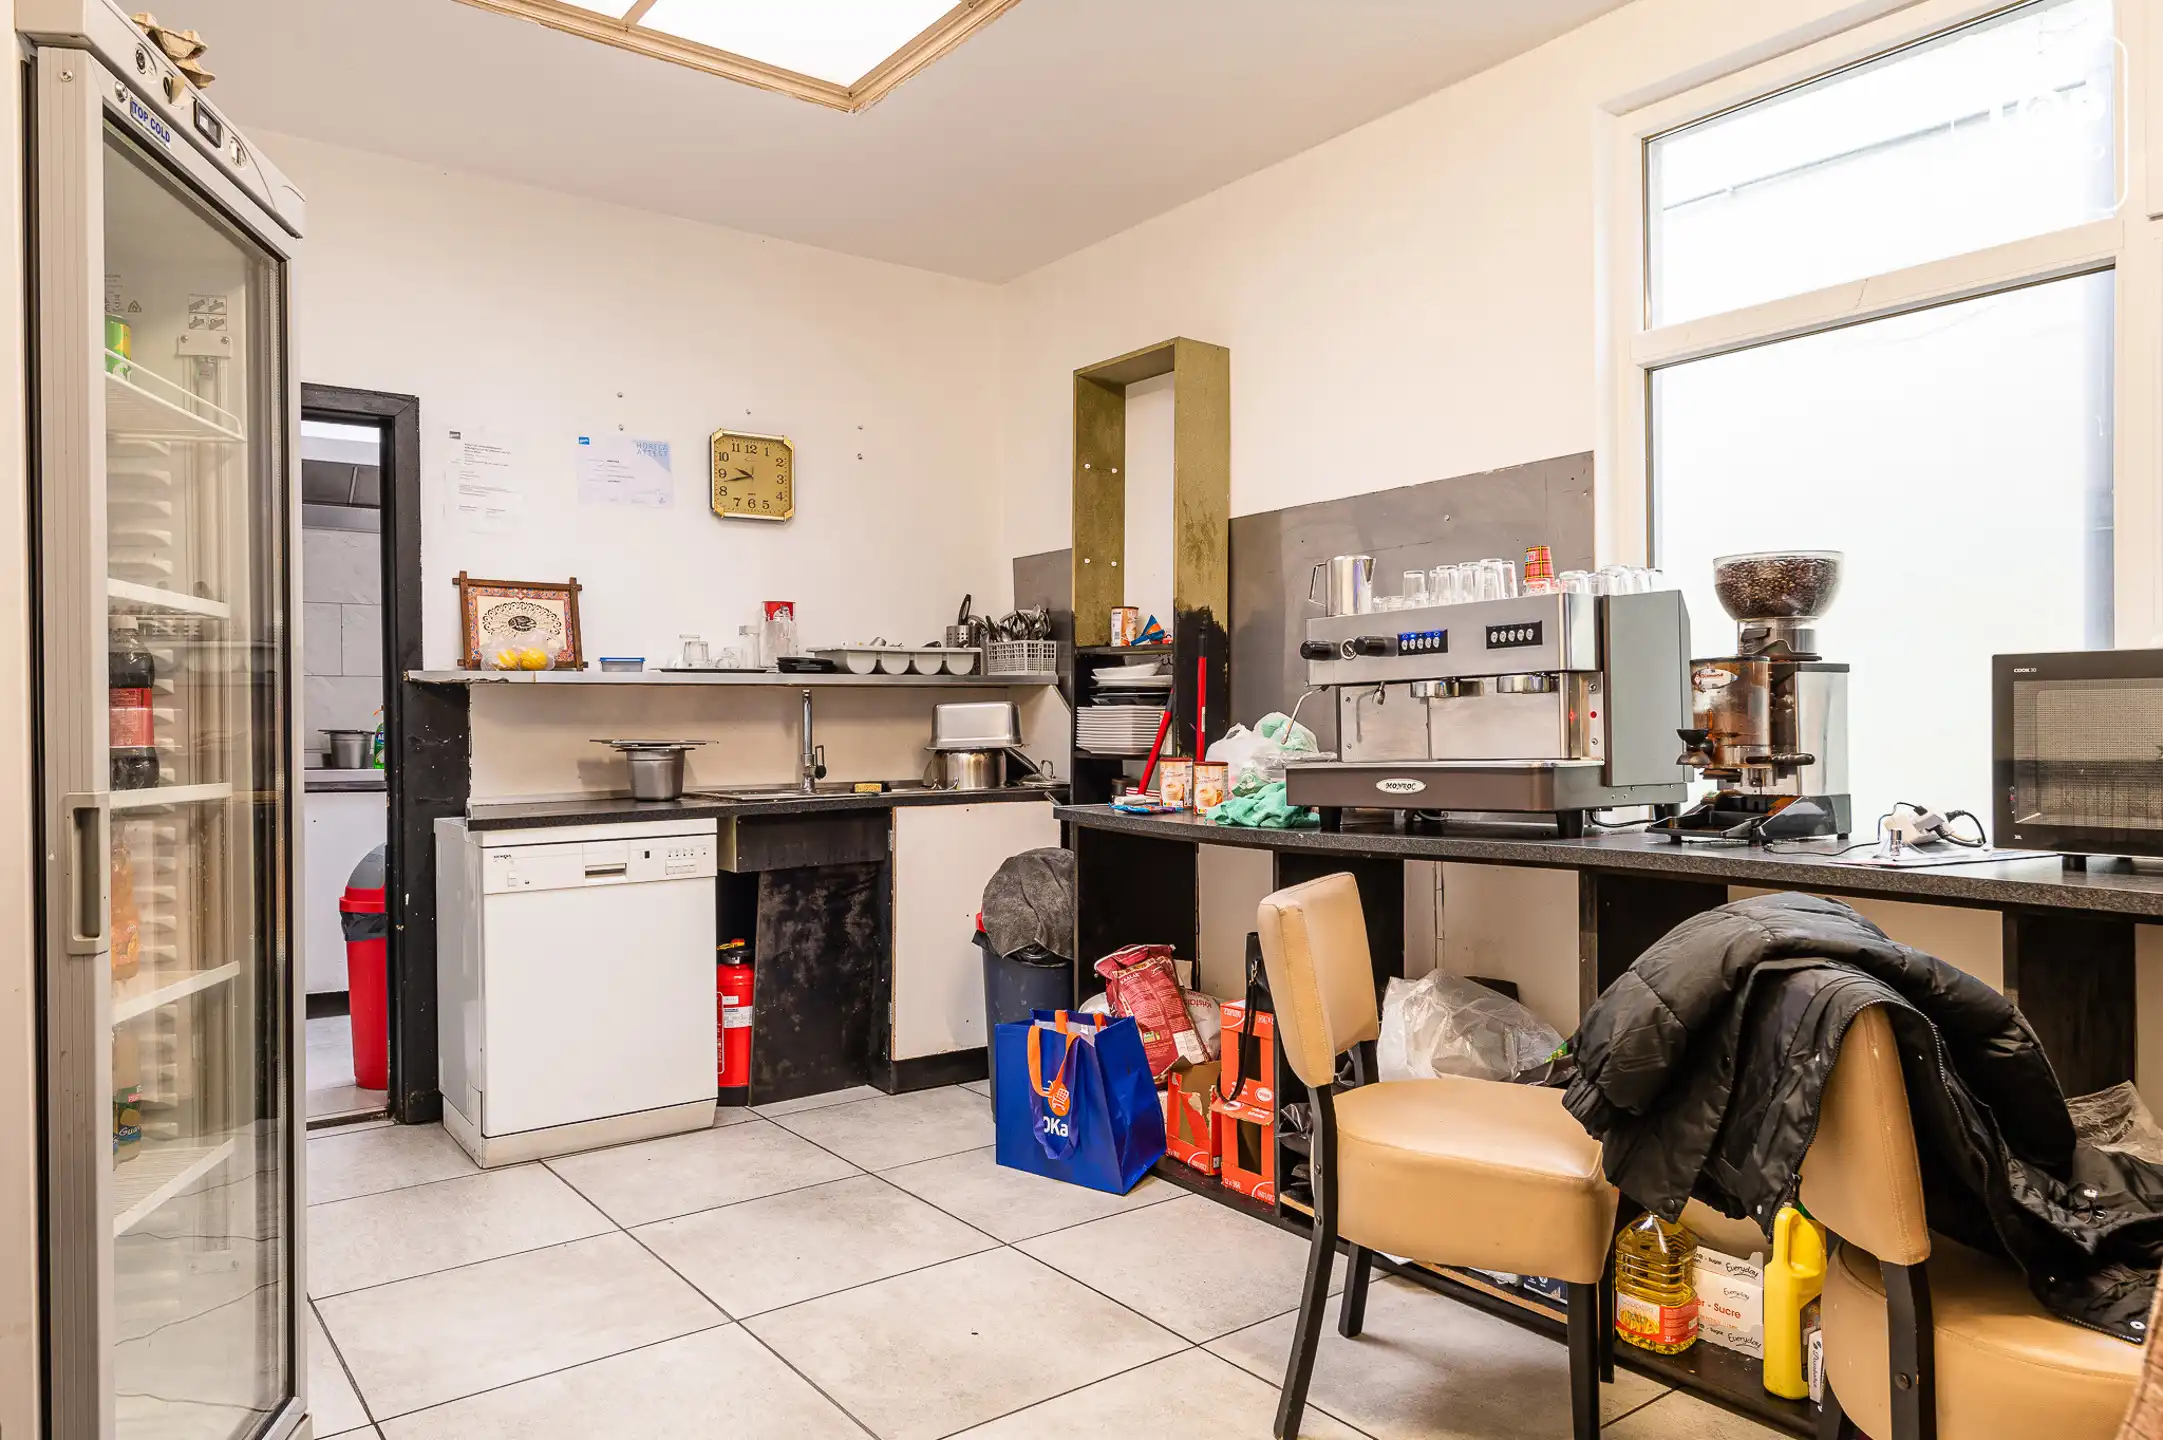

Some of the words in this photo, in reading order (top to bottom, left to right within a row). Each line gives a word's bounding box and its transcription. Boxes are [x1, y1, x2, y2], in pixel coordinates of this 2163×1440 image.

[132, 101, 148, 121] TOP
[151, 118, 170, 142] COLD
[732, 443, 740, 452] 11
[745, 445, 757, 454] 12
[765, 447, 769, 457] 1
[719, 452, 729, 462] 10
[776, 457, 784, 468] 2
[718, 468, 727, 478] 9
[776, 474, 784, 484] 3
[719, 486, 727, 496] 8
[776, 492, 784, 501] 4
[733, 498, 741, 507] 7
[748, 499, 756, 508] 6
[762, 500, 770, 509] 5
[1043, 1116, 1069, 1137] OKa
[1726, 1262, 1759, 1278] Everyday
[1724, 1287, 1750, 1300] Everyday
[1714, 1303, 1741, 1319] Sucre
[1728, 1333, 1762, 1348] Everyday
